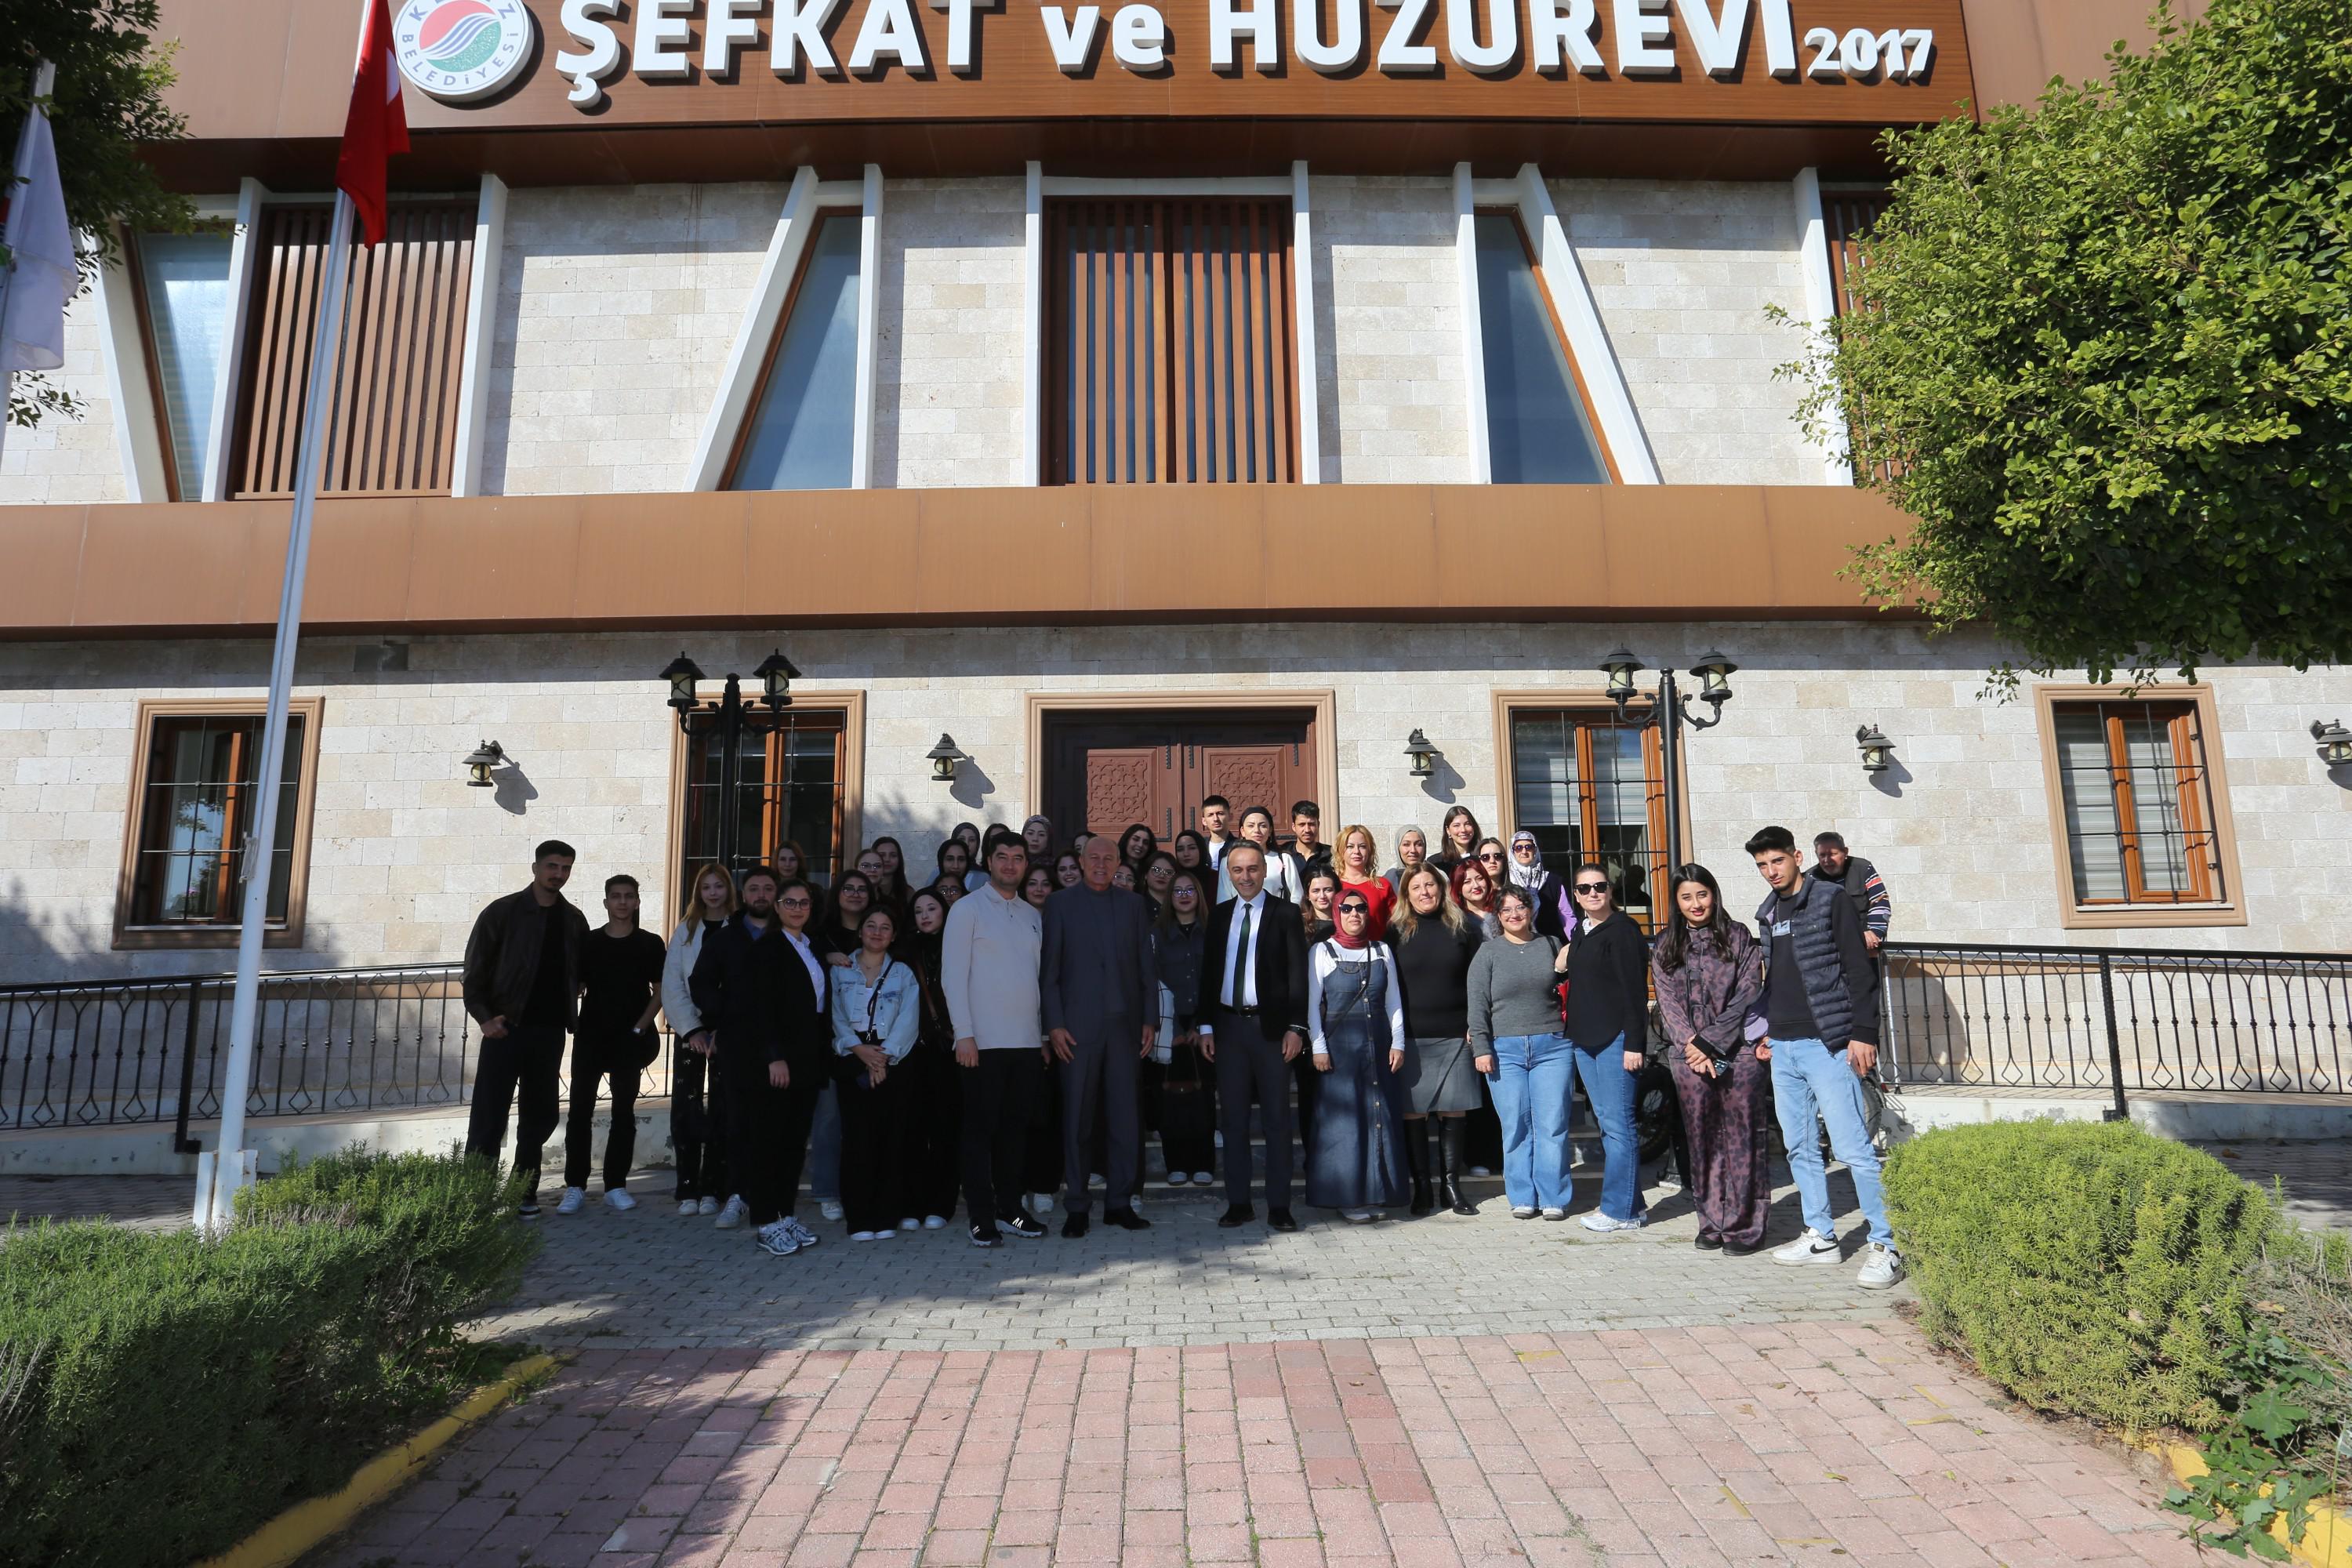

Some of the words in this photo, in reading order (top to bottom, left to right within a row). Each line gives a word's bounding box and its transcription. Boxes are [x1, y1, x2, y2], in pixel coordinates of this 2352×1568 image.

[555, 0, 994, 106] ŞEFKAT
[1040, 4, 1164, 71] ve
[1804, 27, 1933, 78] 2017
